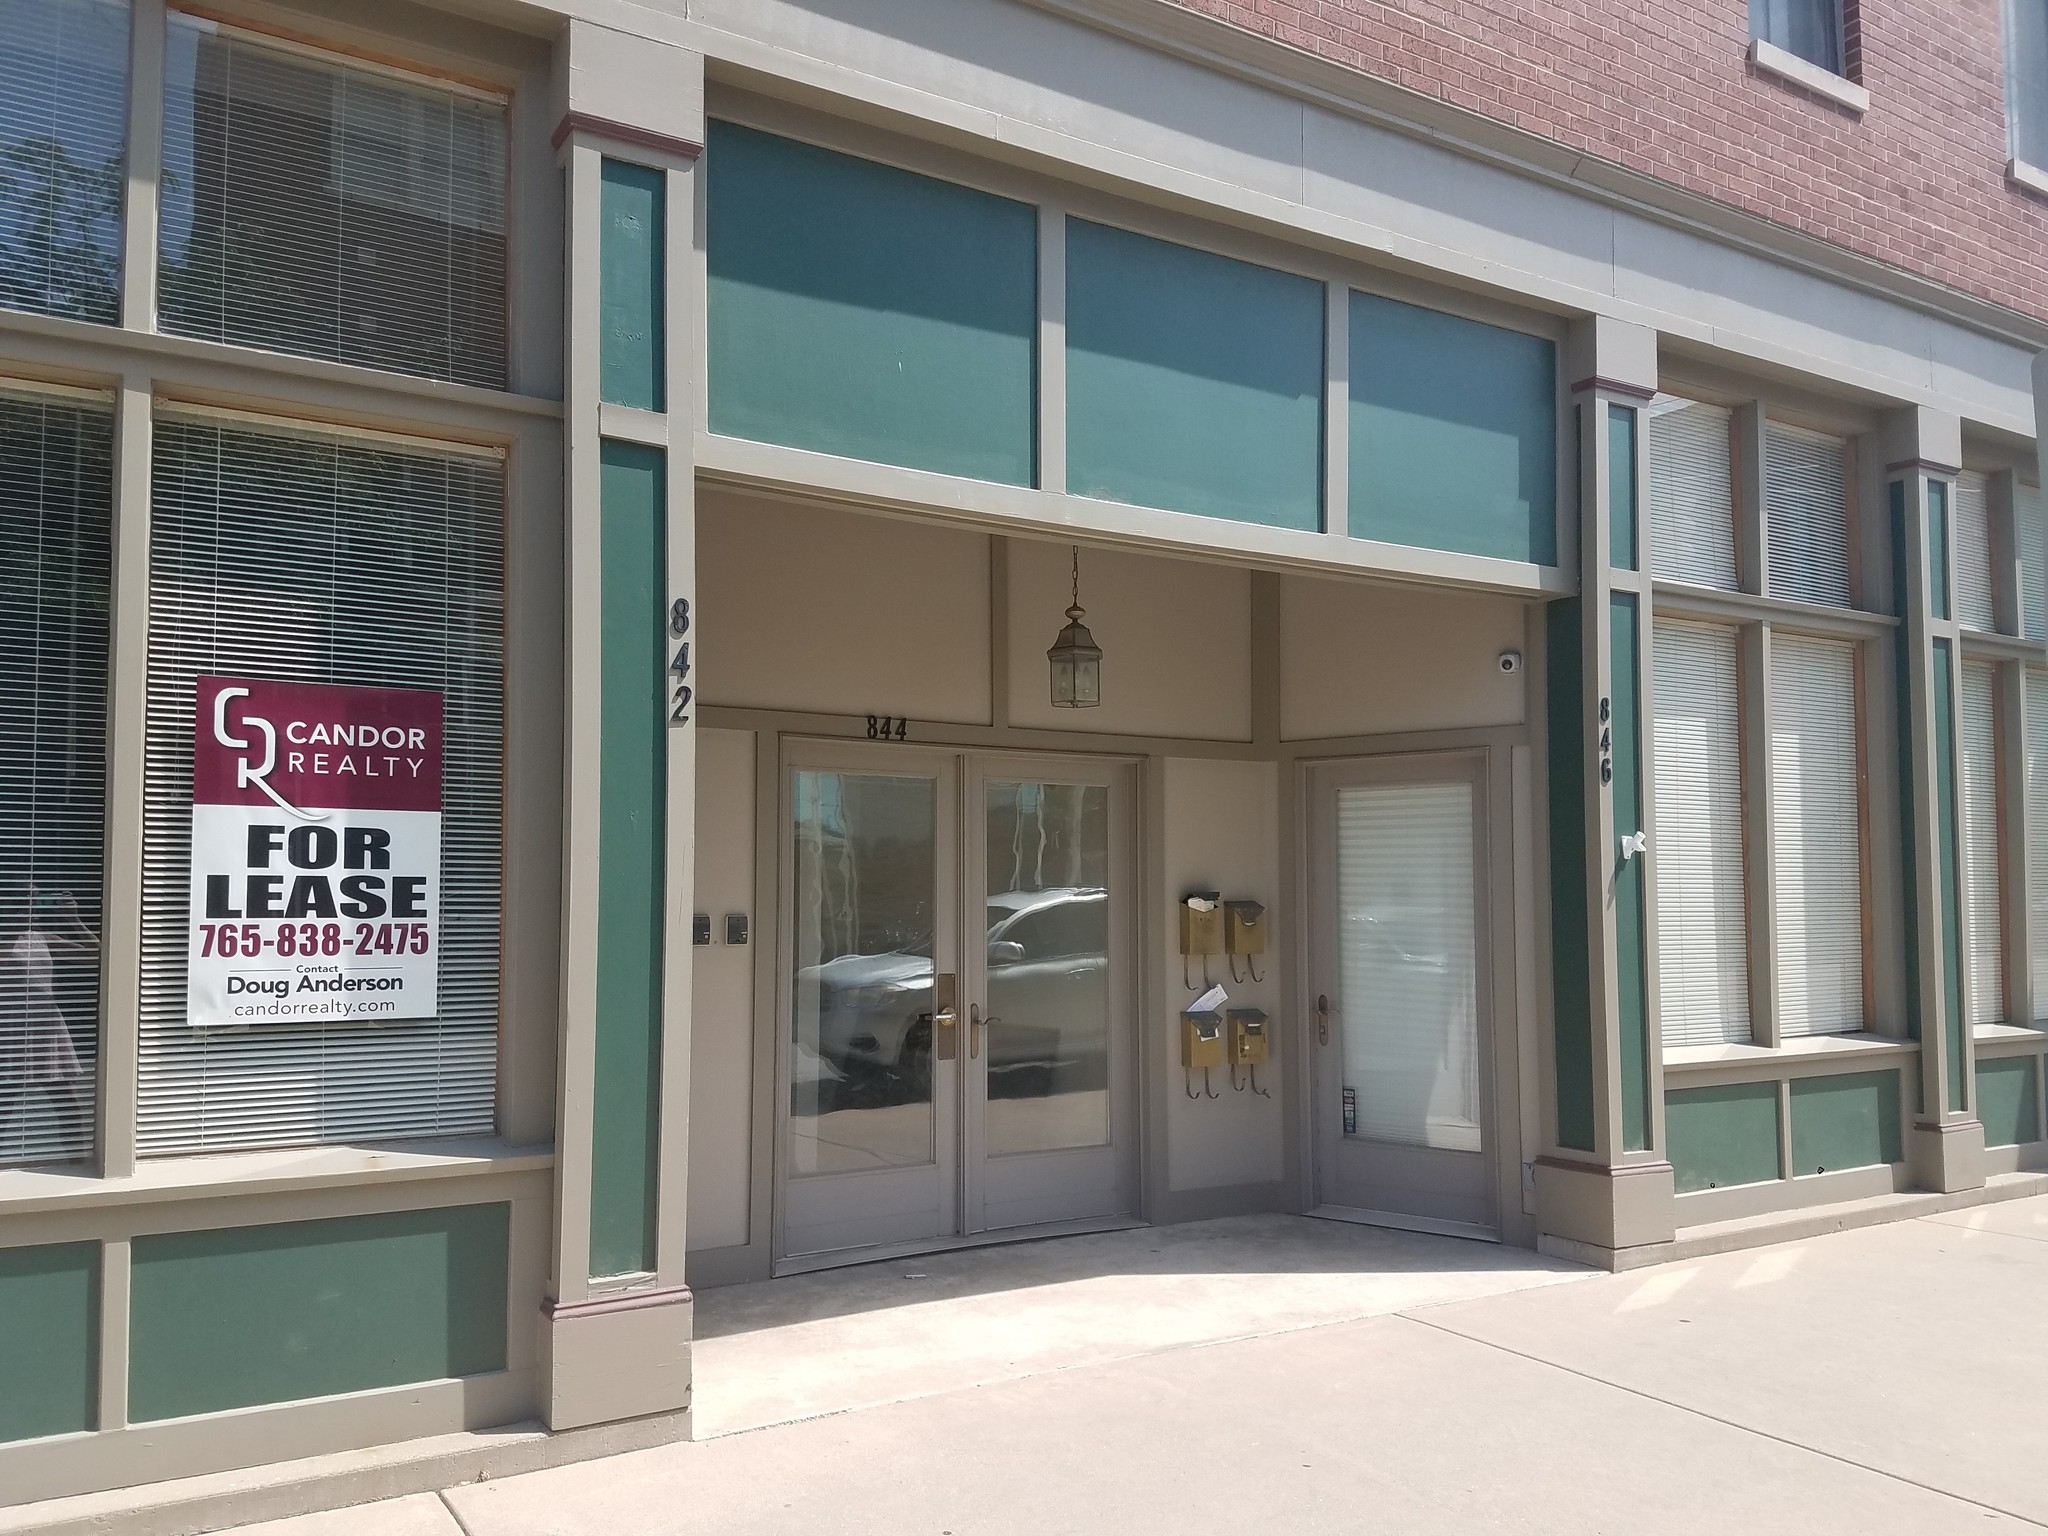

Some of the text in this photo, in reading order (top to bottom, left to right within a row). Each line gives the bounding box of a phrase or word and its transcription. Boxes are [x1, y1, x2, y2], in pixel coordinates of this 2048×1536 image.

[669, 597, 692, 723] 842
[286, 721, 426, 750] CANDOR
[867, 715, 907, 741] 844
[1600, 697, 1612, 783] 846
[288, 751, 425, 778] REALTY
[246, 824, 391, 870] FOR
[204, 873, 428, 919] LEASE
[199, 922, 430, 958] 765-838-2475
[295, 964, 339, 974] Contact
[226, 972, 404, 999] Doug Anderson
[233, 1000, 396, 1017] candorrealty.com
